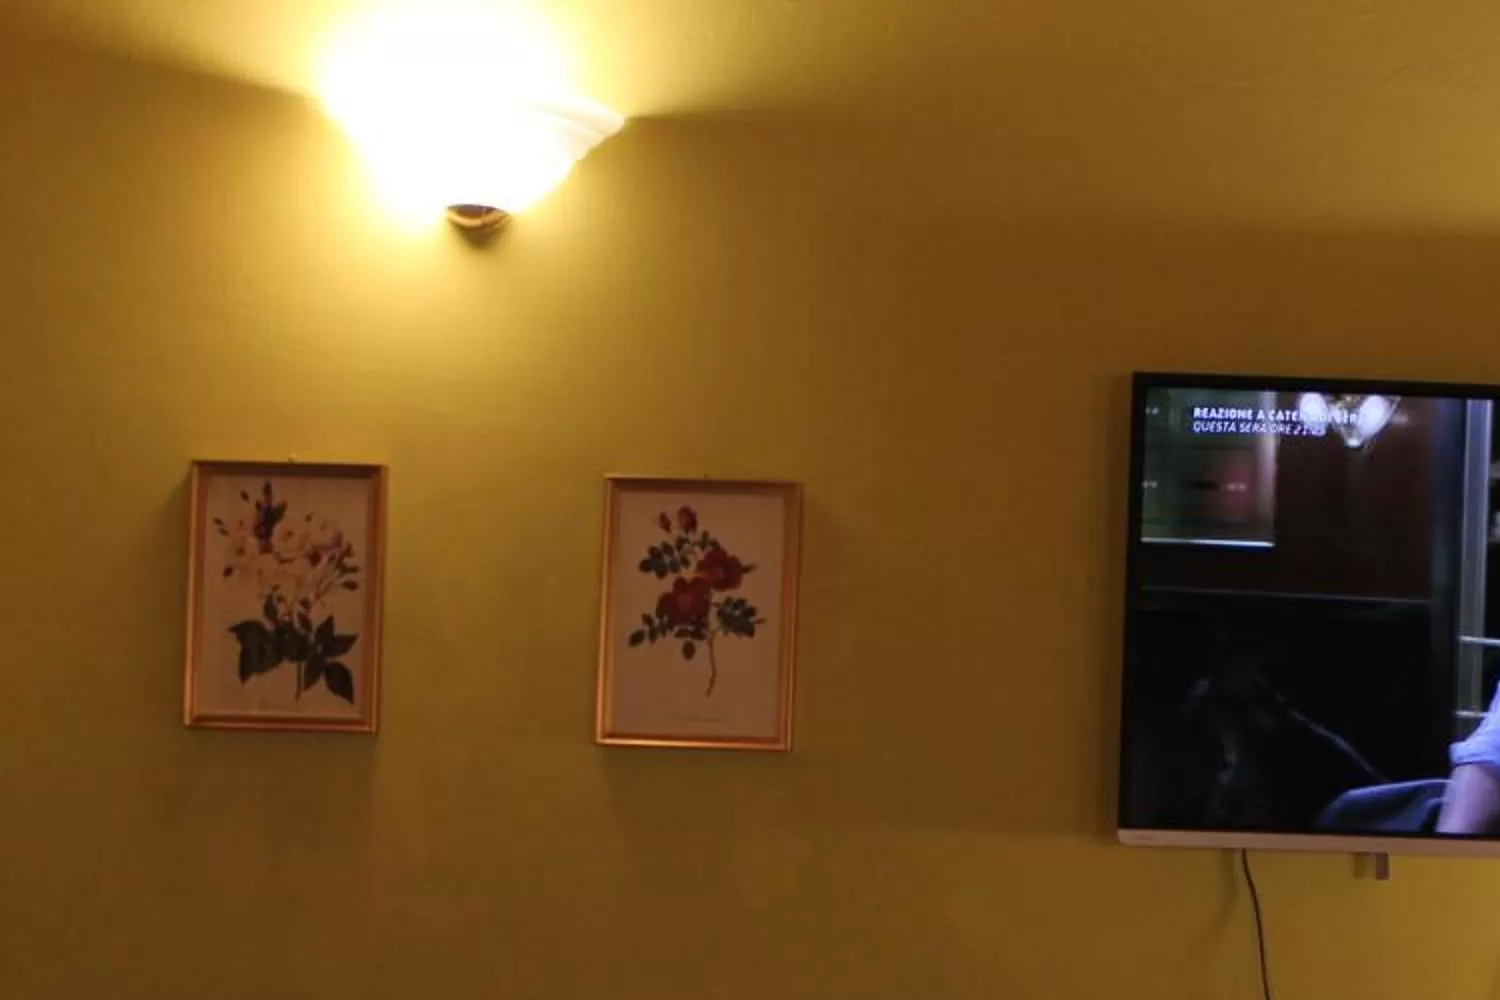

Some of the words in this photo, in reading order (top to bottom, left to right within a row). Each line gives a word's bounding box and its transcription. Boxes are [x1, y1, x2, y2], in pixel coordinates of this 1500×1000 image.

[1193, 407, 1253, 420] REAZIONE
[1256, 409, 1265, 421] A
[1193, 421, 1237, 433] QUESTA
[1239, 422, 1267, 433] SERA
[1270, 422, 1292, 435] ORE
